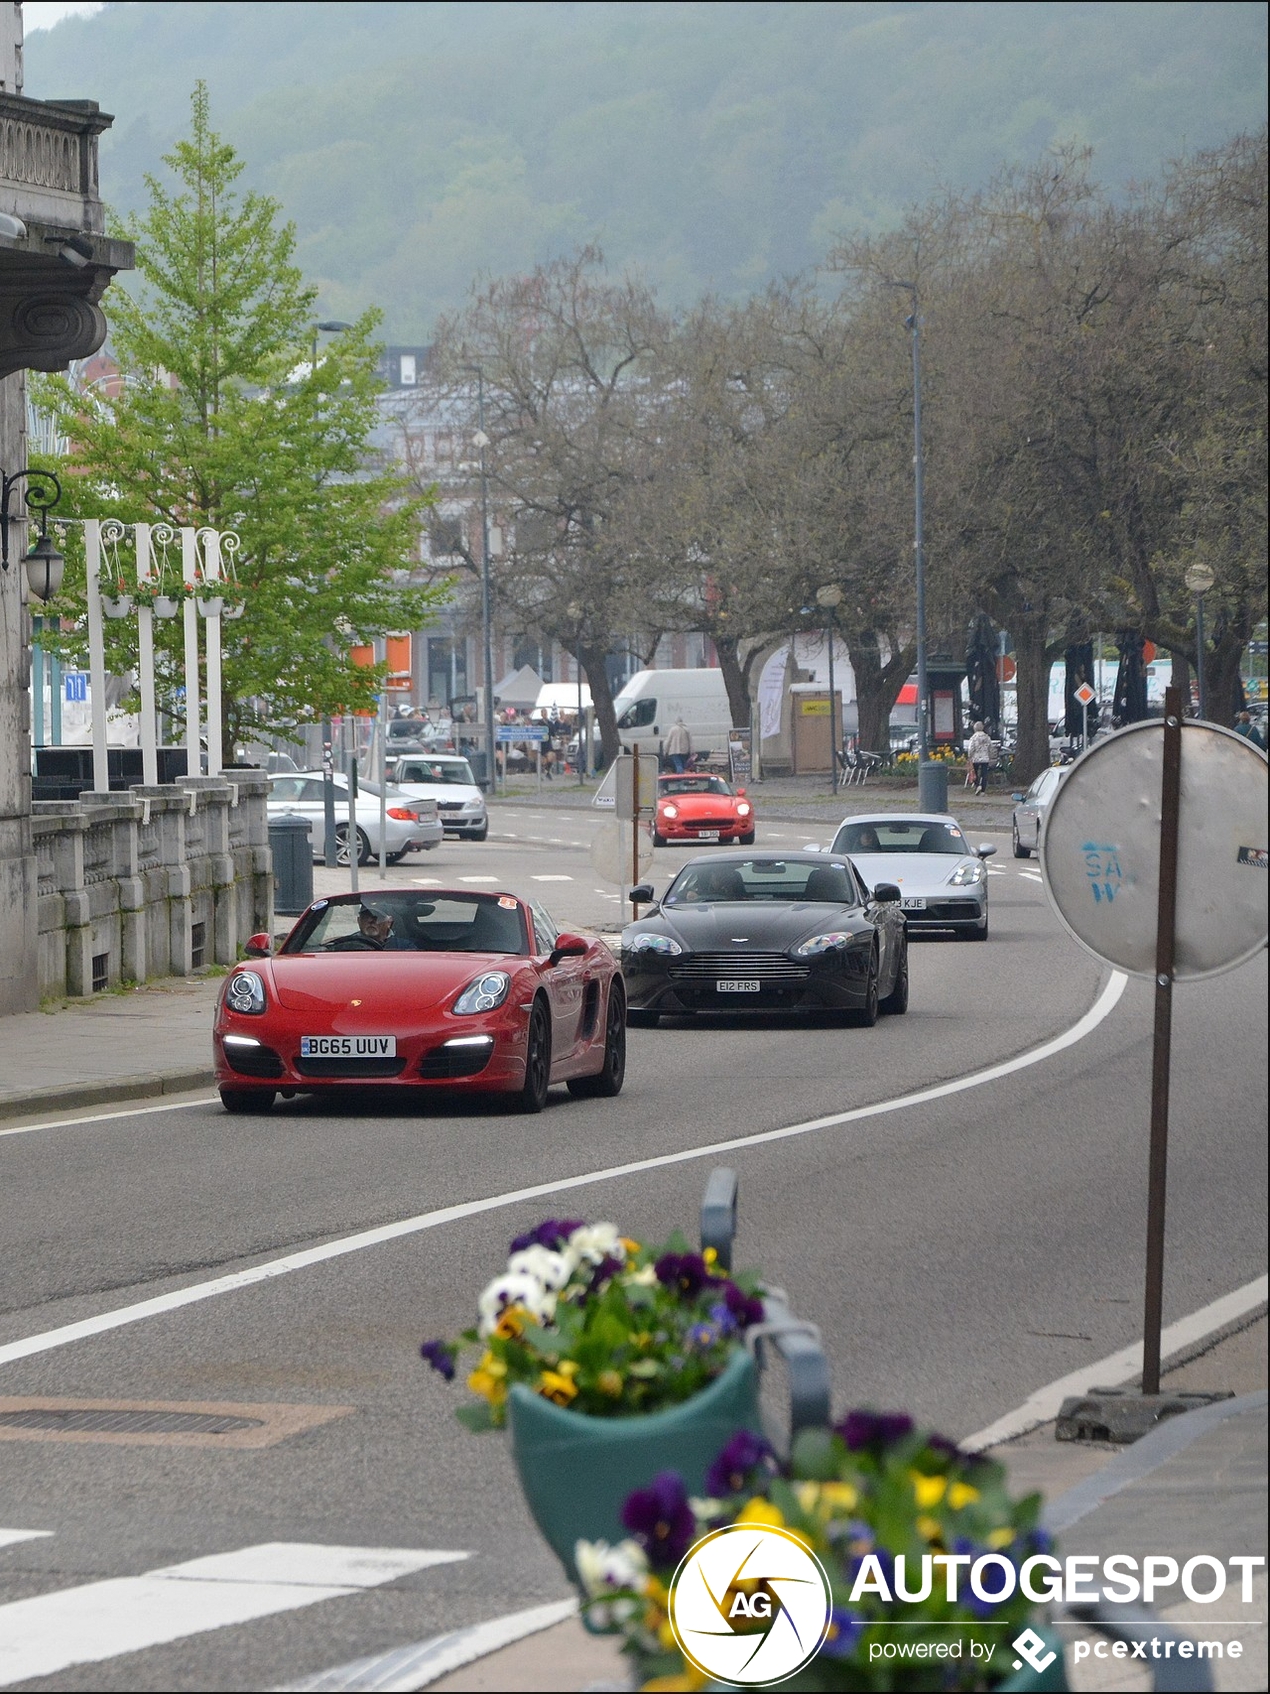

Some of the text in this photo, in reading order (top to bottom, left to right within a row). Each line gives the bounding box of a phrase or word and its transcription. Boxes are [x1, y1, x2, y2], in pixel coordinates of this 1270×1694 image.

[905, 899, 922, 908] KJE
[737, 982, 757, 991] FRS
[309, 1039, 389, 1054] BG65 UUV
